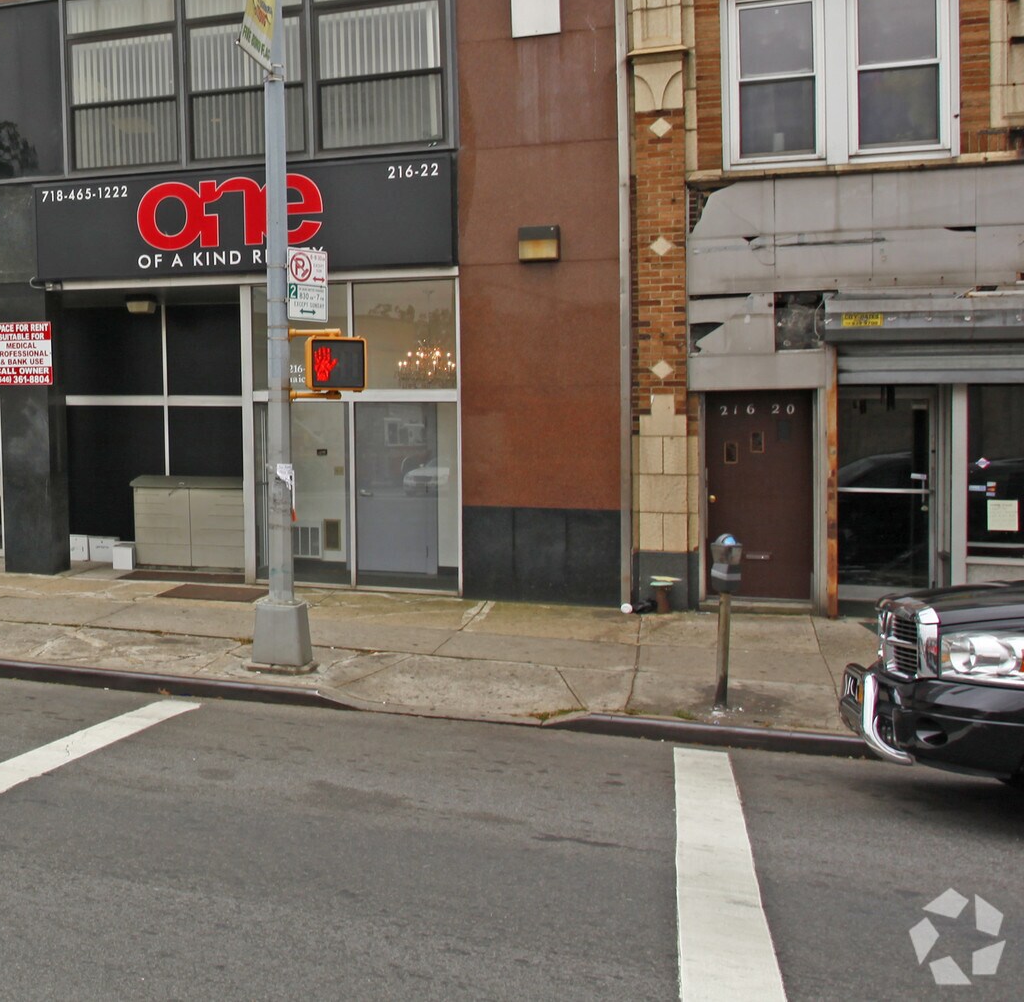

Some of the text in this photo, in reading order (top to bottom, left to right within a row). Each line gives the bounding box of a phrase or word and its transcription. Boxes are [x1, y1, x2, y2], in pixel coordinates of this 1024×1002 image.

[388, 162, 439, 179] 216-22
[42, 185, 128, 203] 718-465-1222
[136, 173, 323, 251] one
[138, 254, 162, 269] OF
[171, 253, 184, 268] A
[193, 250, 241, 267] KIND
[15, 324, 29, 332] FOR
[30, 323, 49, 332] RENT
[18, 367, 50, 375] OWNER
[12, 375, 50, 384] 361-8804
[719, 403, 795, 416] 216 20
